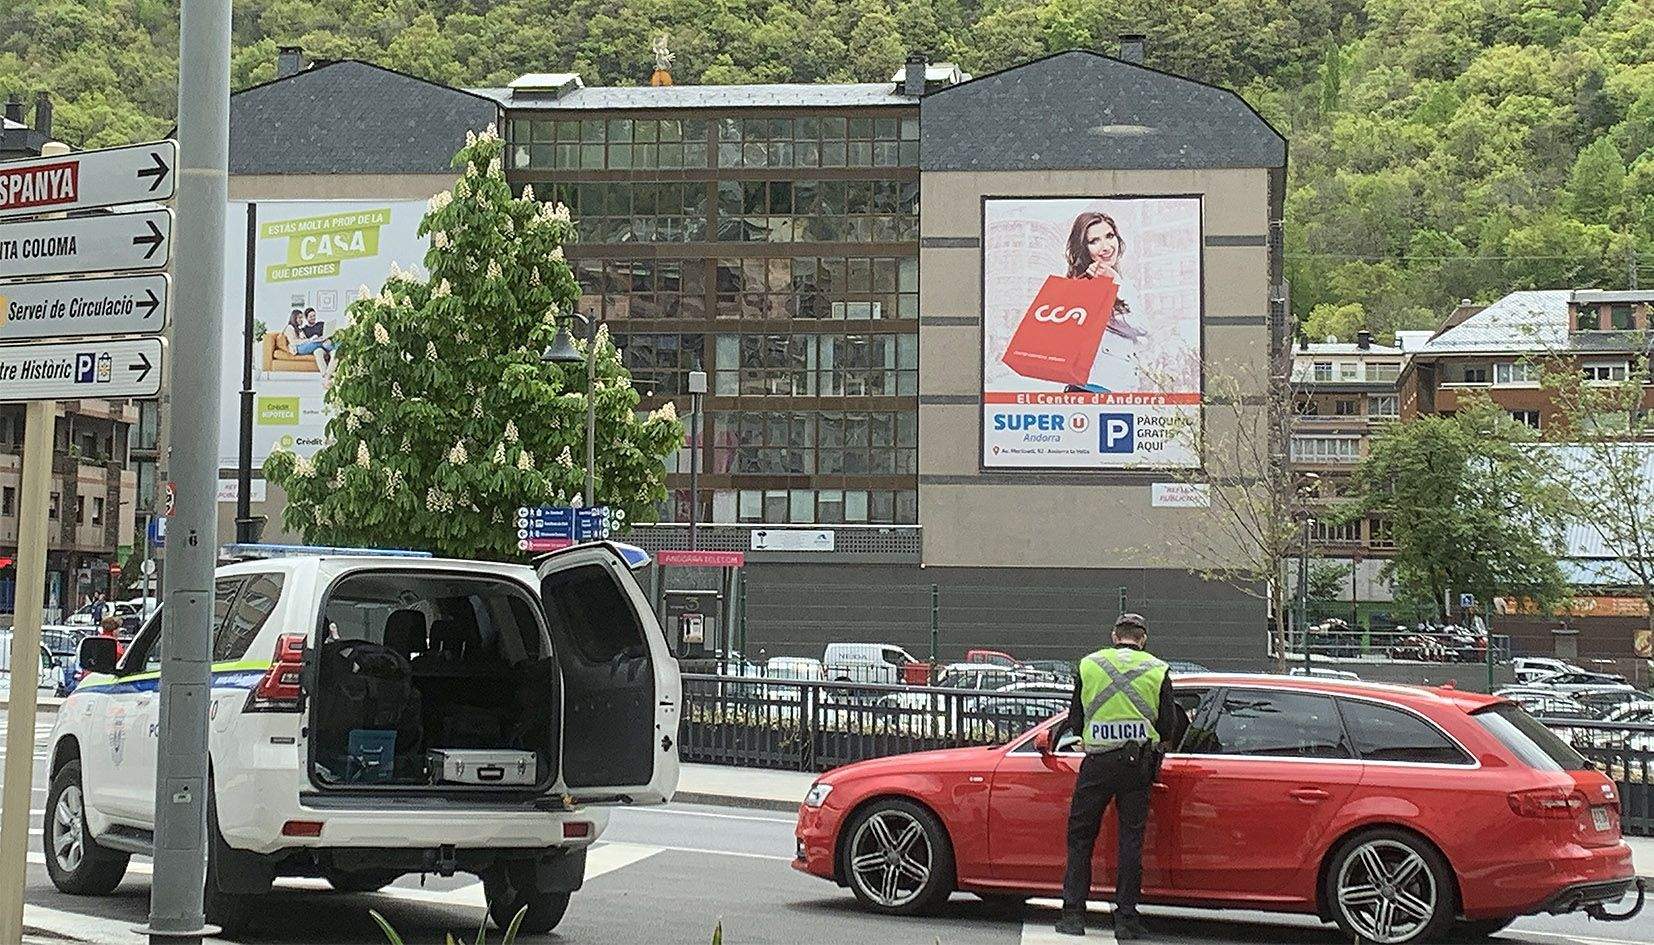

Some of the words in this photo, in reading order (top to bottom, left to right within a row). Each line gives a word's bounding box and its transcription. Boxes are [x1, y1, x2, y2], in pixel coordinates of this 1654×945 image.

[332, 214, 357, 229] PROP
[372, 212, 384, 223] LA
[22, 236, 77, 259] COLOMA
[300, 230, 366, 261] CASA
[271, 267, 291, 280] QUE
[291, 262, 336, 278] DESITGES
[7, 299, 49, 321] Servei
[49, 299, 66, 319] de
[68, 294, 134, 318] Circulació
[20, 358, 72, 380] Històric
[1016, 393, 1031, 404] El
[1037, 393, 1085, 404] Centre
[993, 413, 1065, 431] SUPER
[1022, 433, 1062, 442] Andorra
[1106, 419, 1130, 448] P
[1092, 724, 1147, 739] POLICIA
